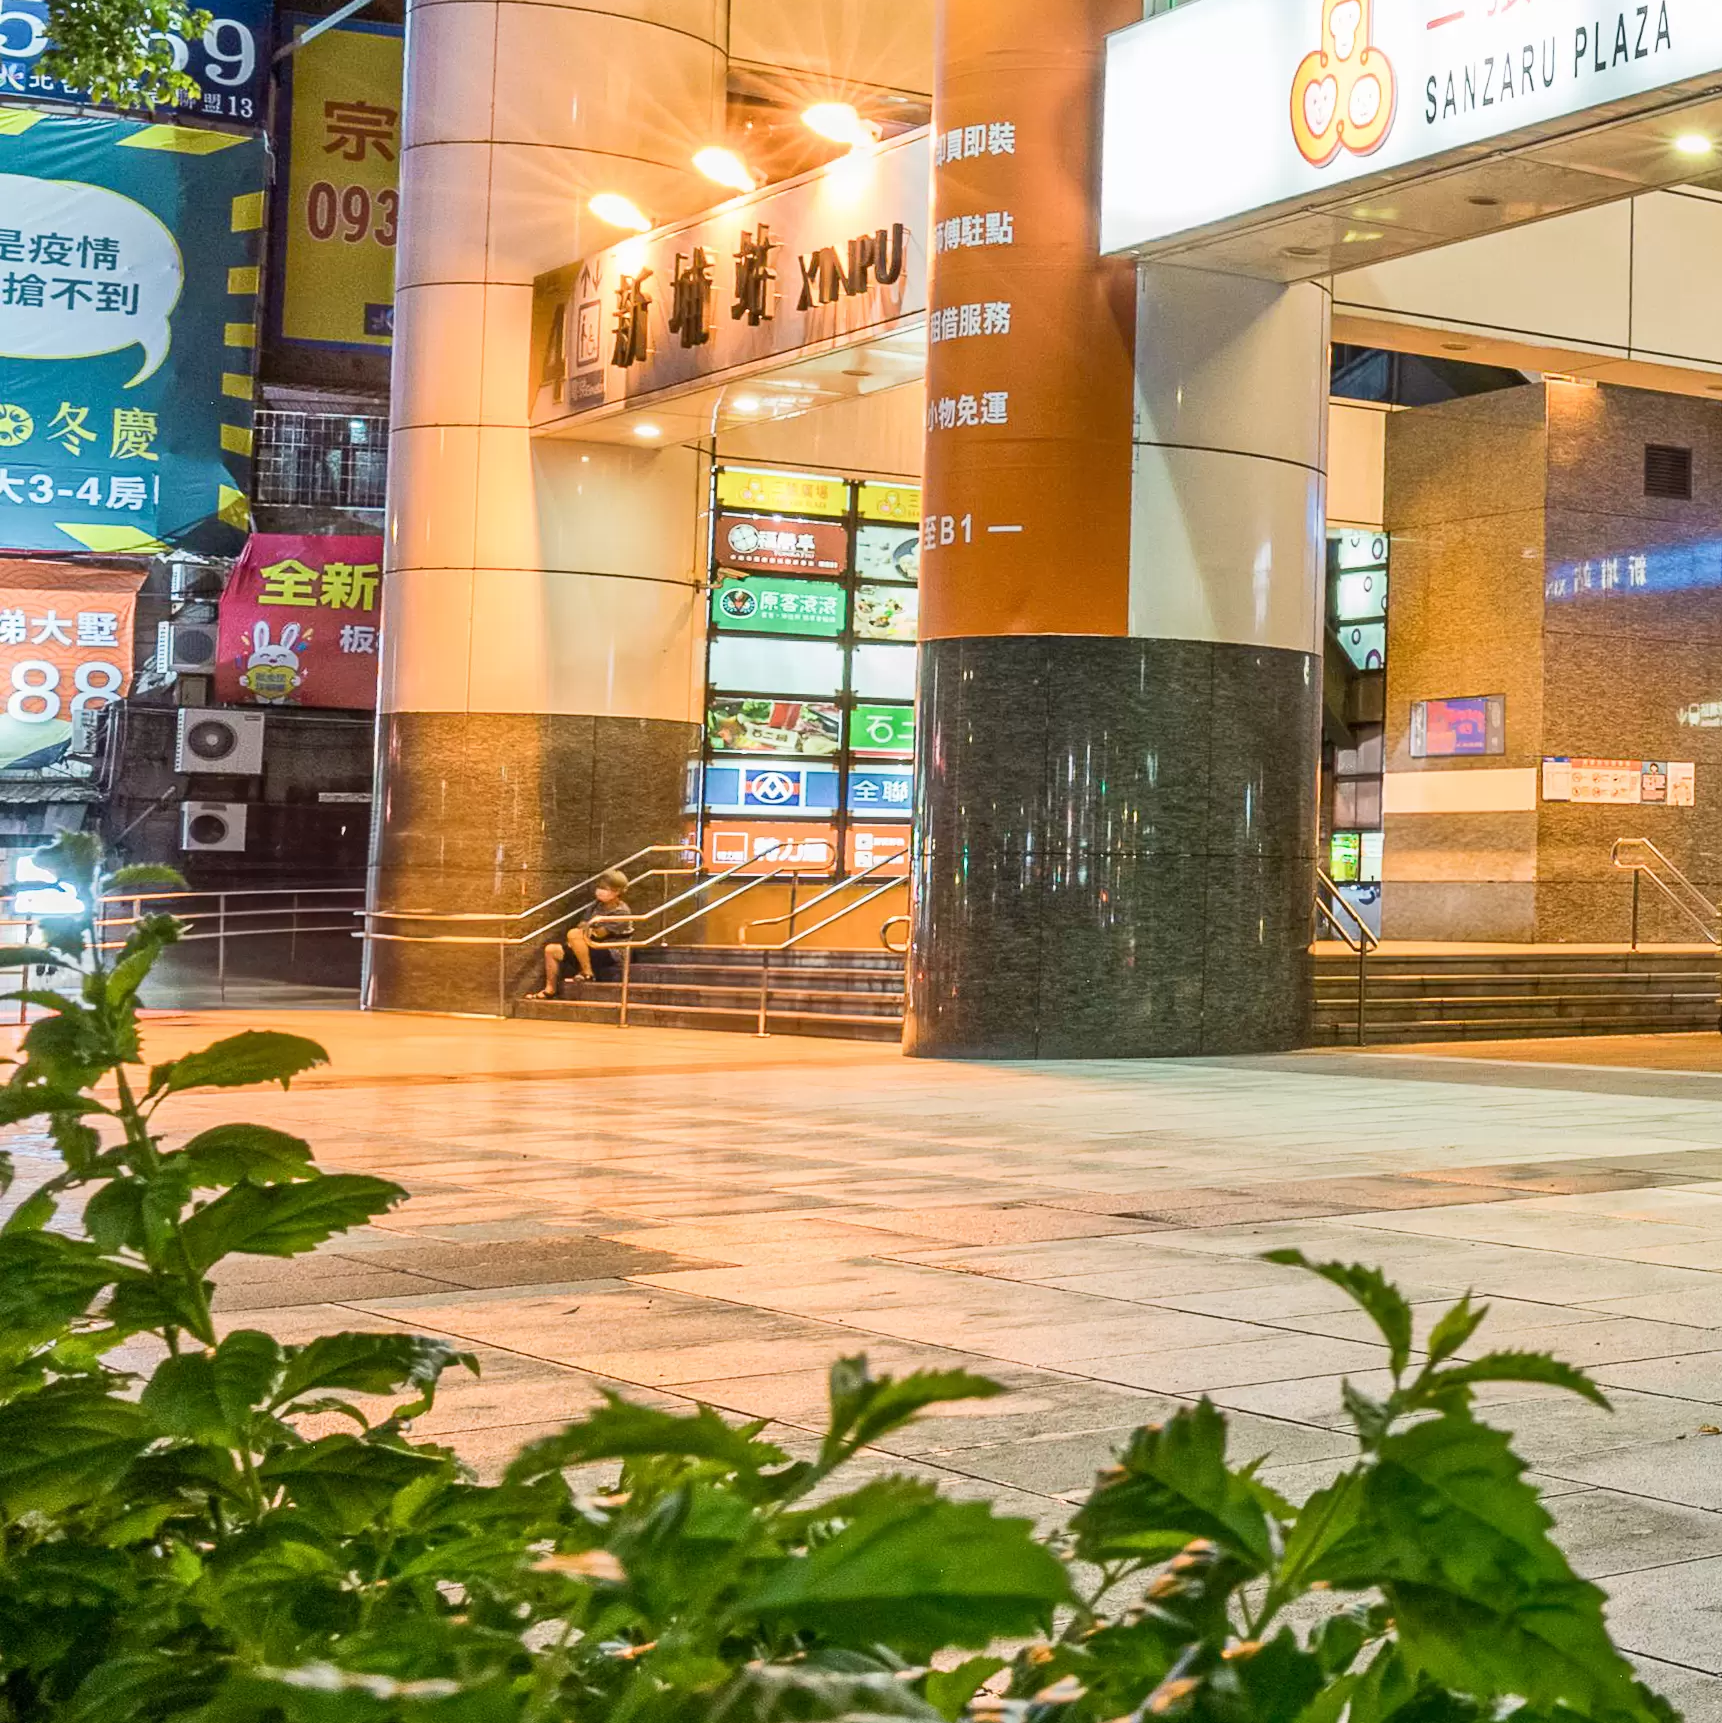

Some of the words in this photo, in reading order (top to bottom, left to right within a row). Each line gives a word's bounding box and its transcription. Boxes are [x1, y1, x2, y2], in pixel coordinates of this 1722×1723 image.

[1424, 35, 1556, 126] SANZARU
[1573, 0, 1672, 79] PLAZA
[323, 101, 398, 162] 宗
[2, 271, 140, 316] 搶不到
[47, 401, 160, 462] 冬慶
[258, 559, 380, 611] 全新
[339, 624, 380, 655] 板
[852, 779, 910, 804] 全聯
